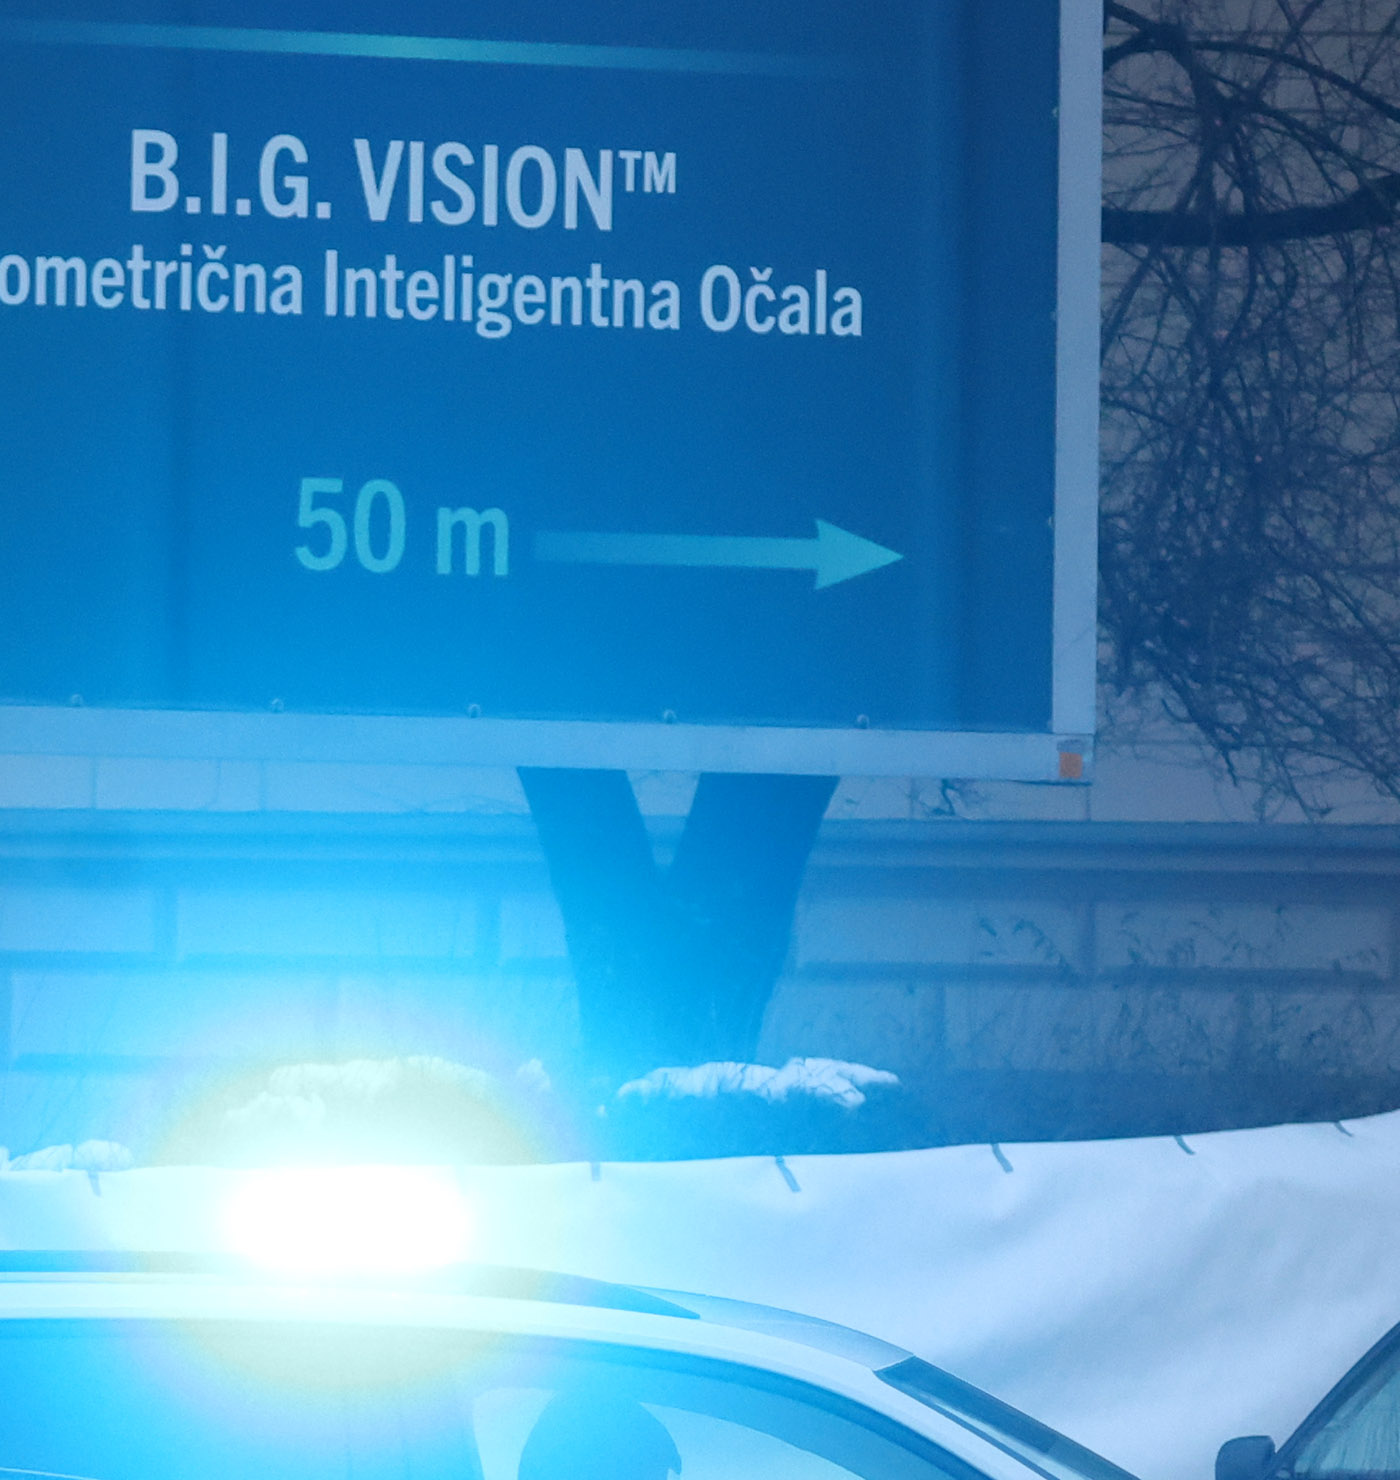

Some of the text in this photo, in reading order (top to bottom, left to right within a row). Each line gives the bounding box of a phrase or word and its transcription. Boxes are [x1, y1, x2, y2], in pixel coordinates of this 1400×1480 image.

[128, 129, 333, 220] B.I.G.
[324, 250, 682, 339] Inteligentna
[699, 264, 864, 337] Očala
[293, 478, 510, 577] 50 m
